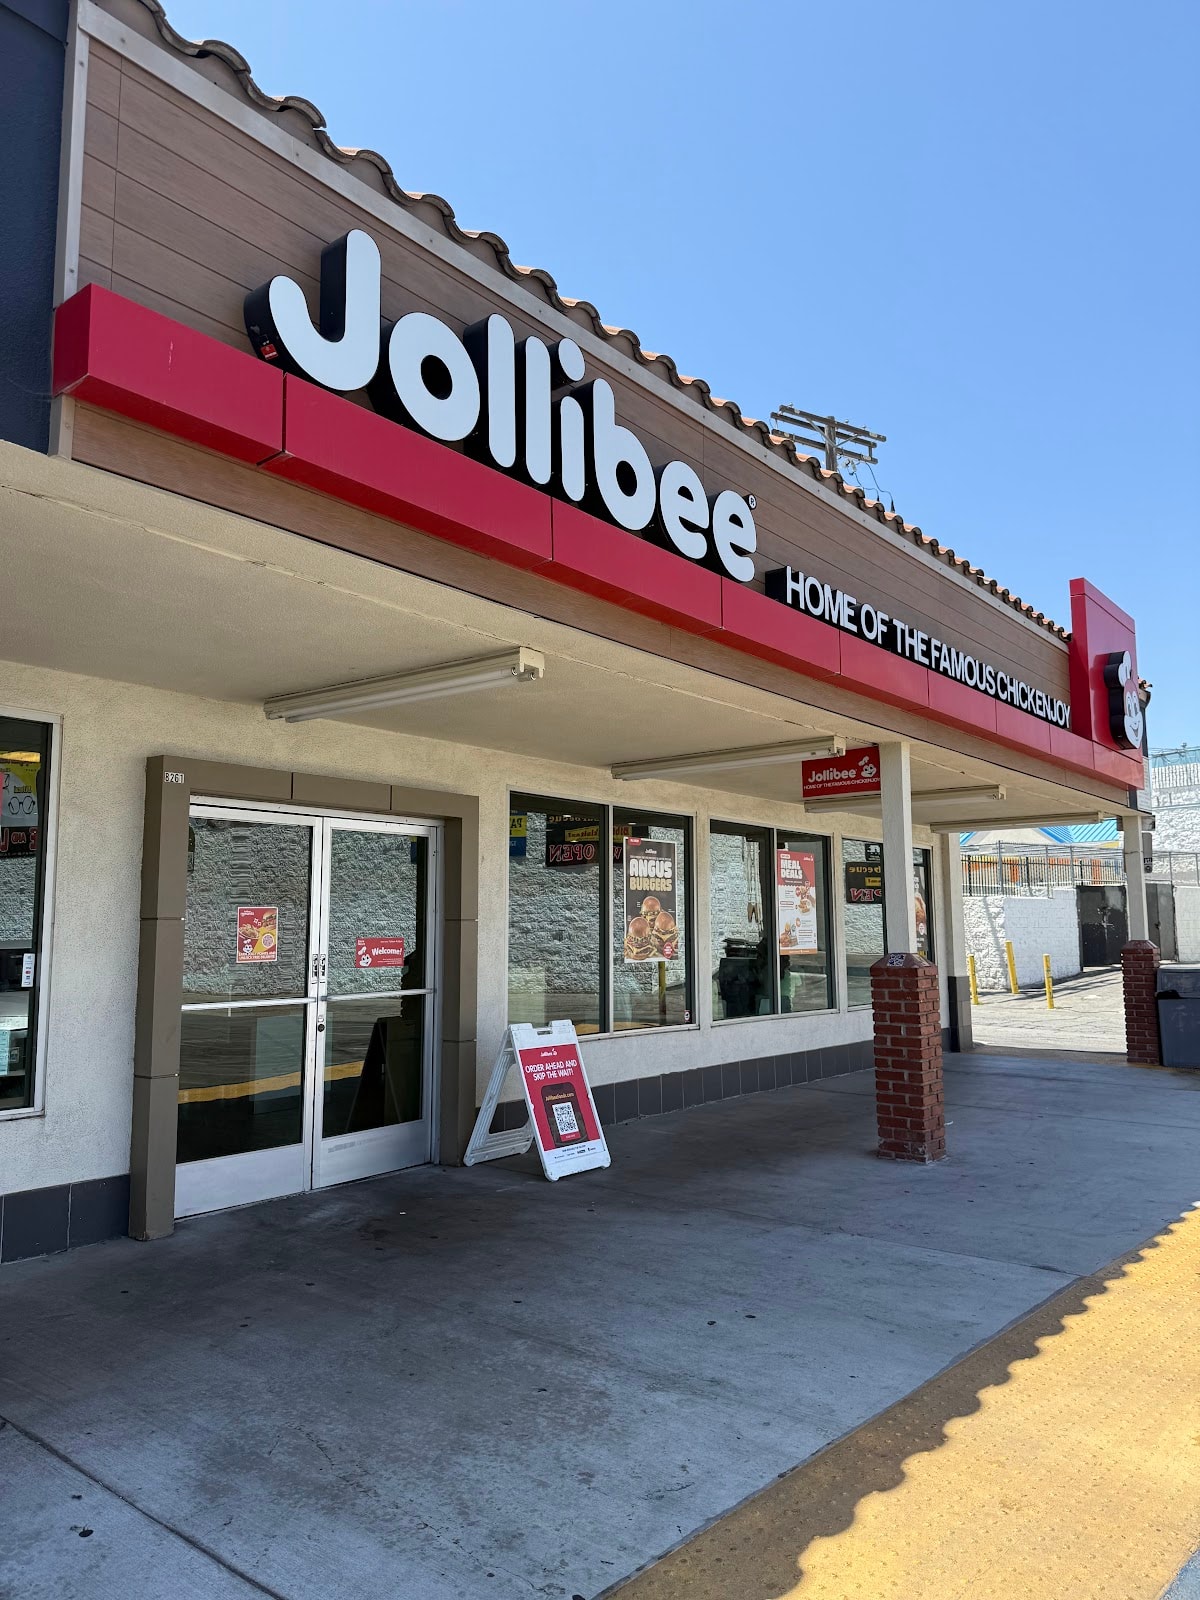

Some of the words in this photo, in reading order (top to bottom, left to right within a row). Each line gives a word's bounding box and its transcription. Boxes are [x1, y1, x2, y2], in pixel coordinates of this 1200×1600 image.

[266, 228, 758, 583] Jollibee
[786, 565, 858, 633] HOME
[860, 603, 890, 645] OF
[892, 618, 930, 666] THE
[930, 637, 996, 696] FAMOUS
[996, 671, 1071, 729] CHICKENJOY
[808, 768, 857, 783] Jollibee
[630, 859, 672, 878] ANGUS
[781, 869, 803, 879] DEALS
[630, 877, 672, 891] BURGERS
[372, 947, 403, 956] Welcome!
[525, 1063, 545, 1073] ORDER
[545, 1061, 565, 1070] AHEAD
[565, 1060, 578, 1068] AND
[533, 1072, 546, 1081] SKIP
[546, 1070, 558, 1079] THE
[558, 1068, 574, 1077] WAIT!
